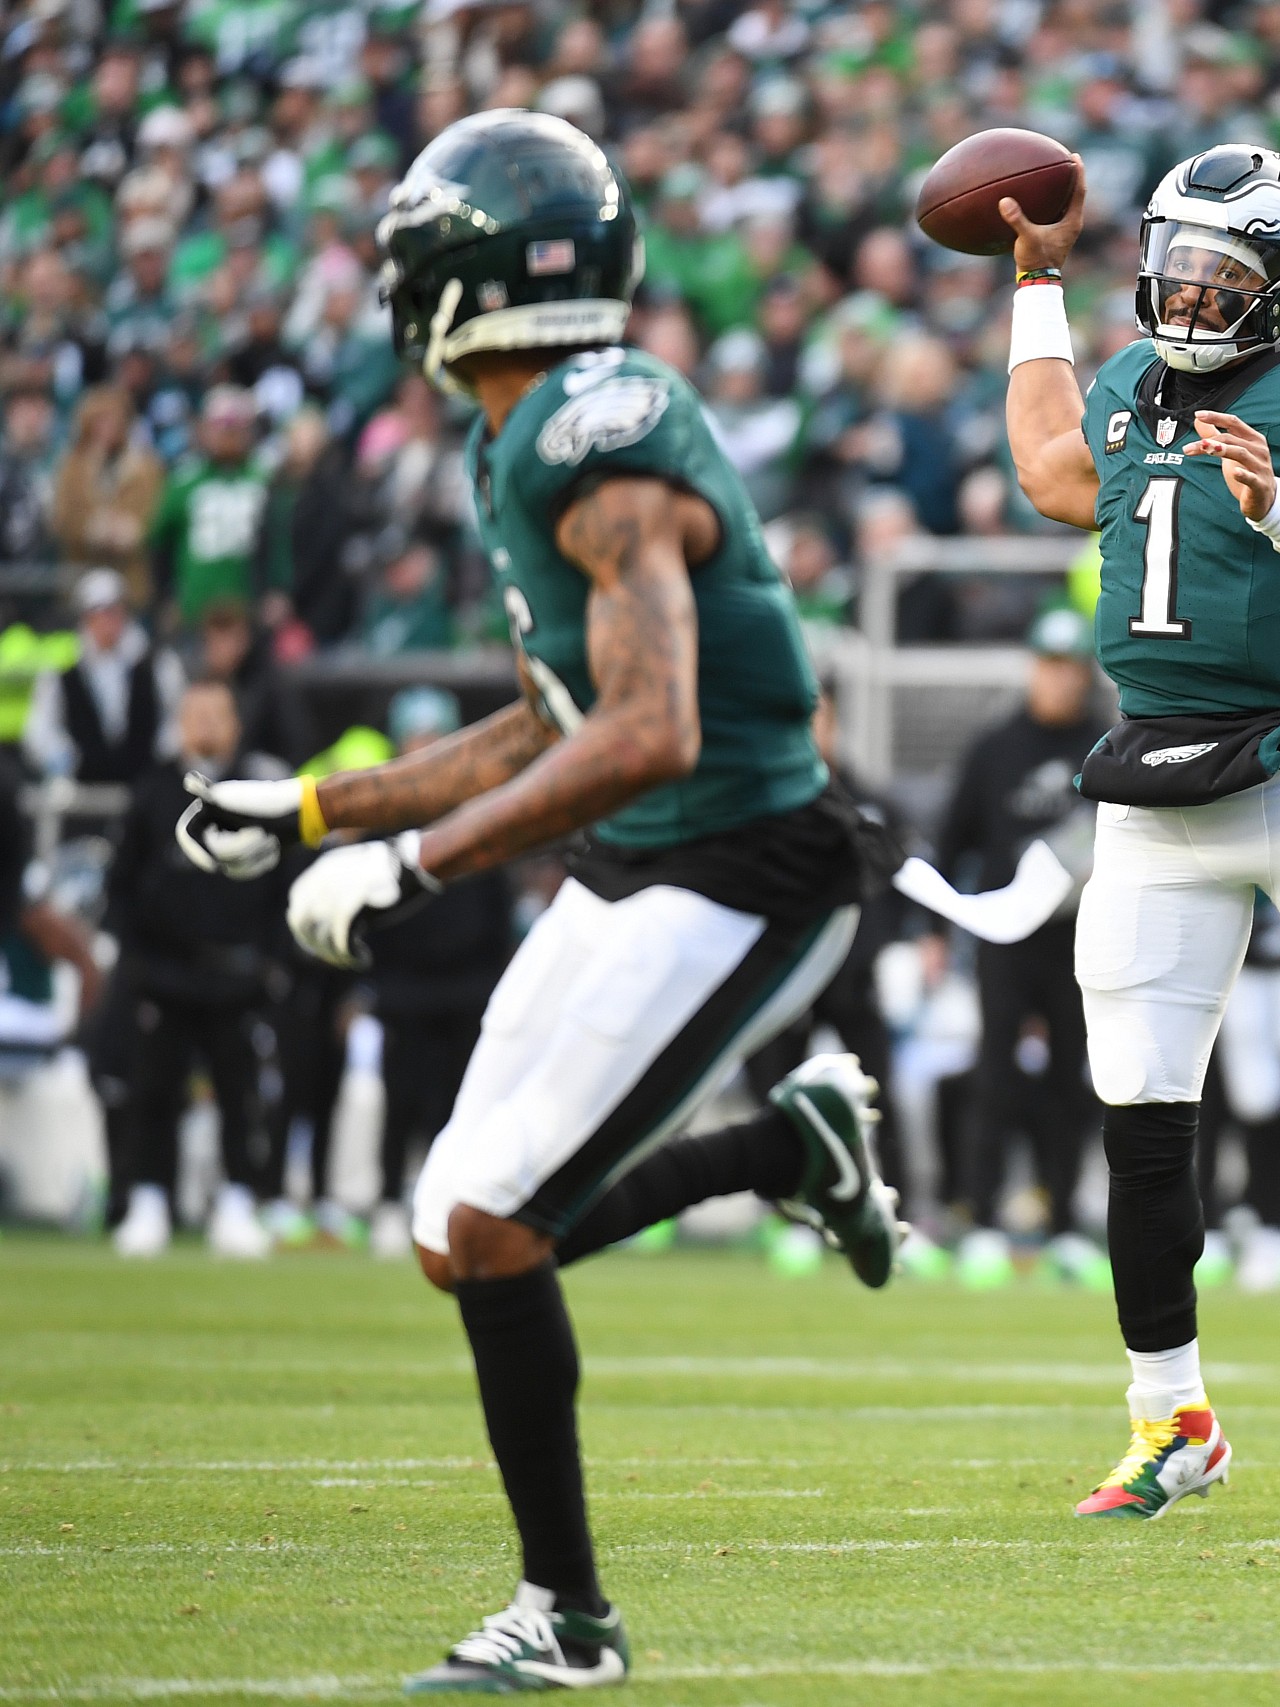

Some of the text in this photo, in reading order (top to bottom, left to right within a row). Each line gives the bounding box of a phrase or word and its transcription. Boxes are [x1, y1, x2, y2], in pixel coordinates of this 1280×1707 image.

[1107, 411, 1131, 443] C
[1143, 452, 1185, 466] EAGLES
[1128, 475, 1192, 641] 1
